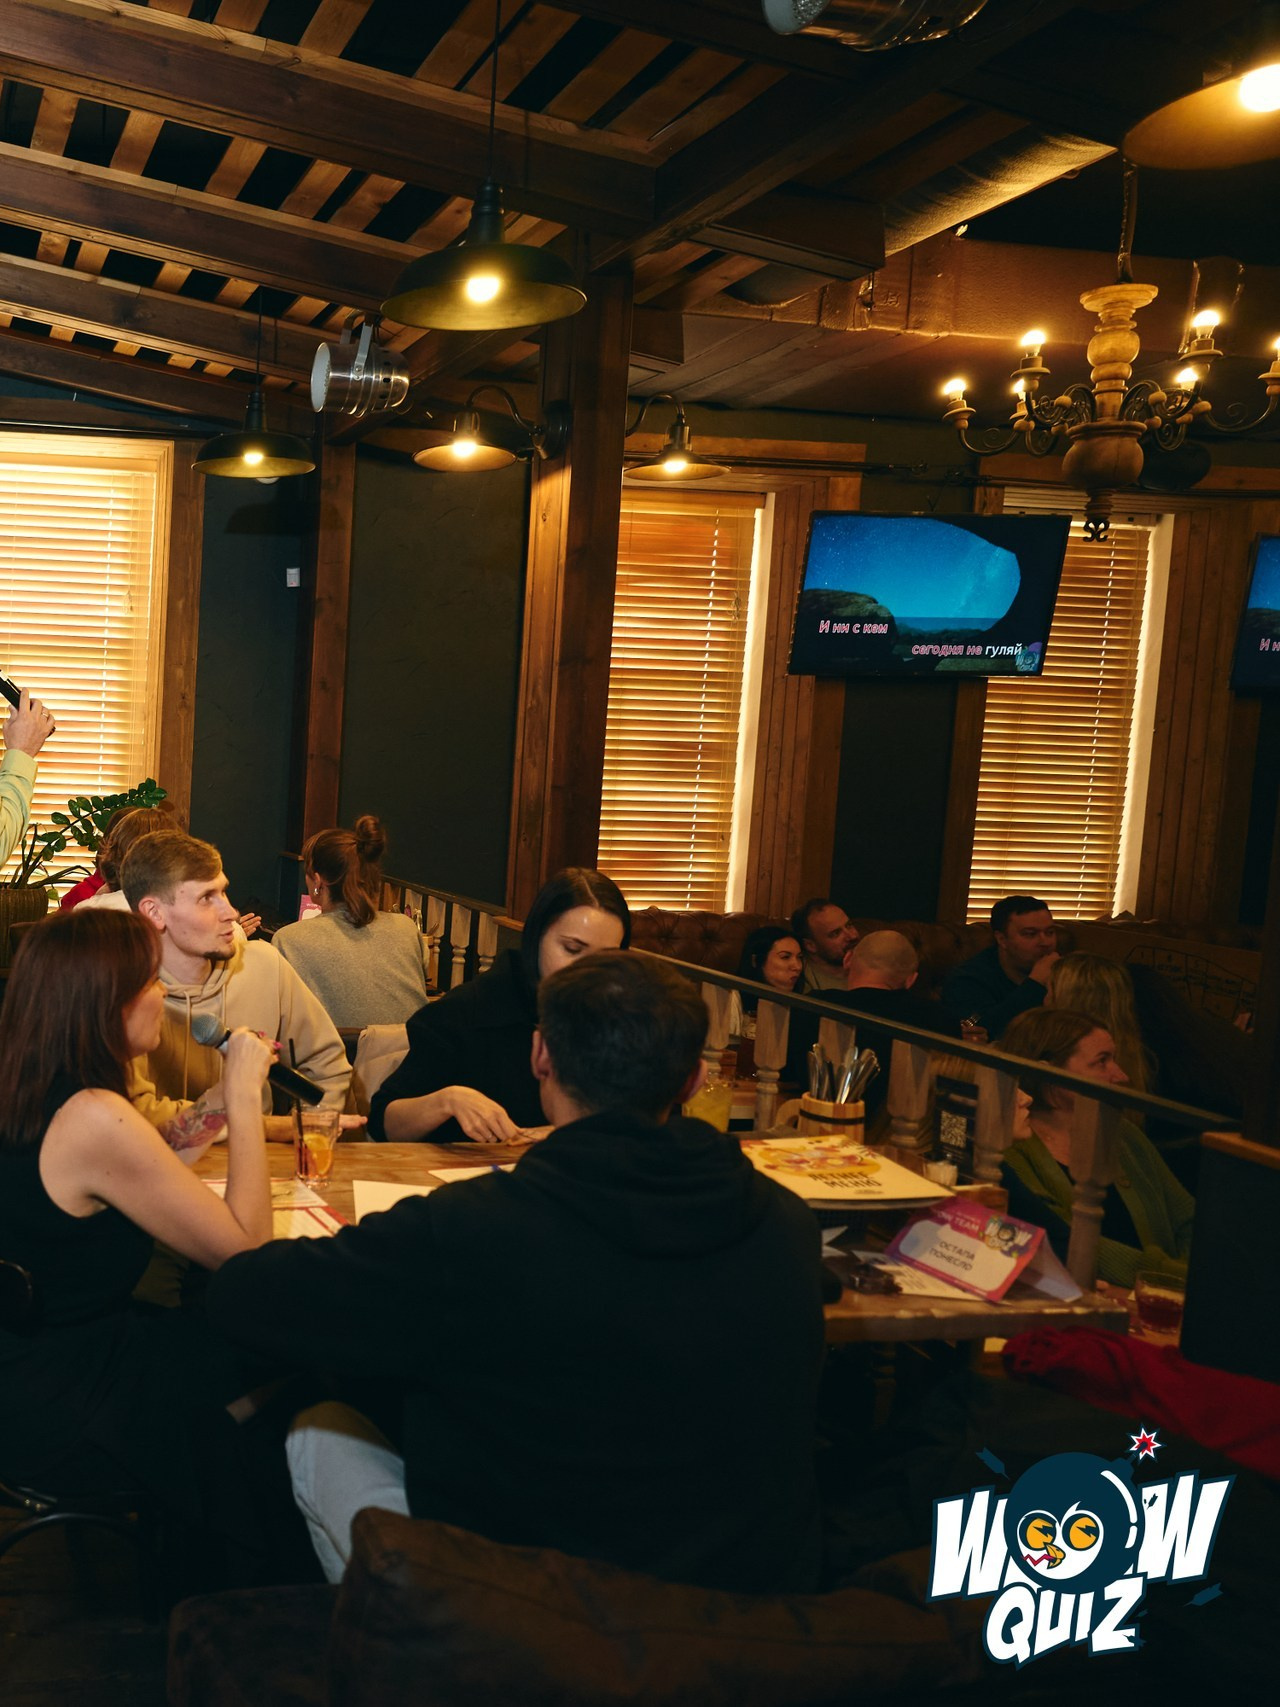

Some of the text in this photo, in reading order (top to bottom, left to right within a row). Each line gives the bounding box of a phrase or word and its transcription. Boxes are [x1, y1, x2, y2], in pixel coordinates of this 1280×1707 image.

[819, 620, 889, 634] И ни с кем
[911, 643, 1022, 658] сегодня не гуляй
[1259, 638, 1270, 651] И
[824, 1179, 882, 1188] МЕНЮ
[953, 1216, 980, 1232] TEAM
[939, 1240, 976, 1261] ОСТАПА
[929, 1247, 973, 1272] ПОНЕСЛО
